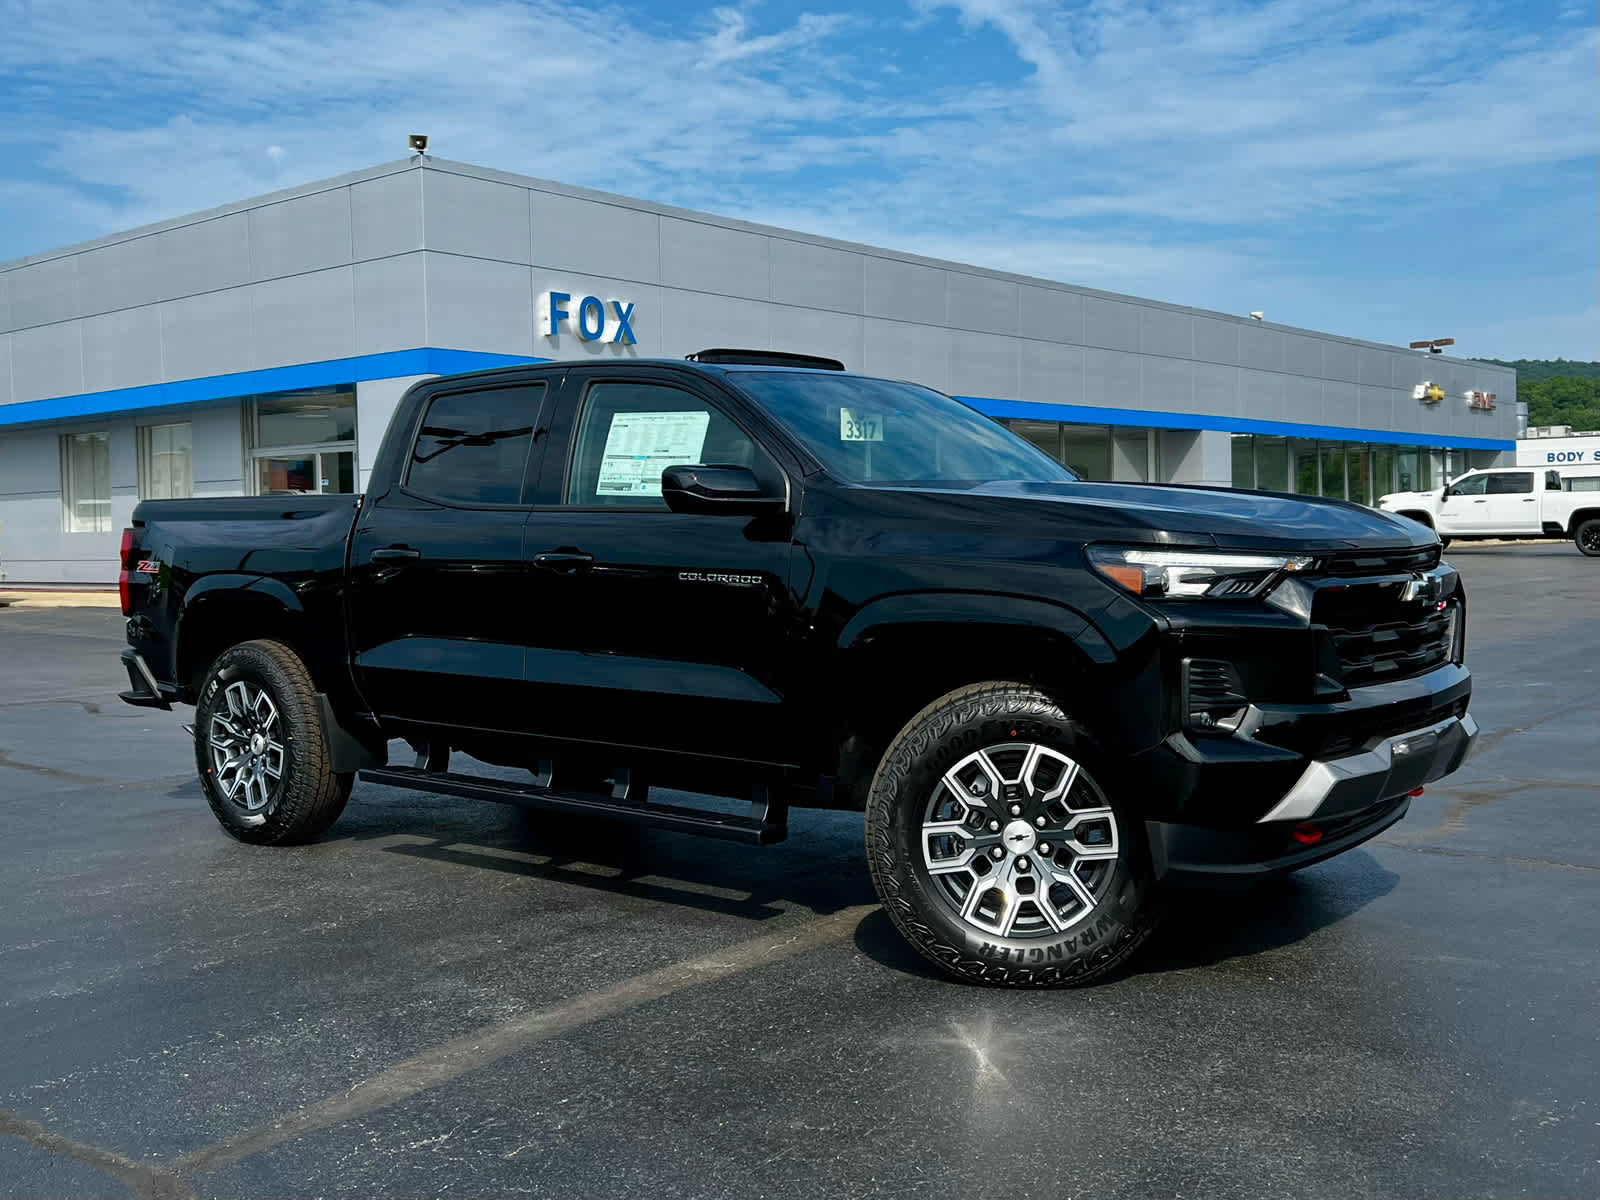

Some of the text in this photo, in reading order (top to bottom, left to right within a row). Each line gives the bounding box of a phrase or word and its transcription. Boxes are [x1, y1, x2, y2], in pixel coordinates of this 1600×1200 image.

[550, 291, 637, 344] FOX
[846, 420, 876, 439] 3317
[1547, 451, 1584, 462] BODY
[679, 572, 762, 584] COLORADO
[978, 912, 1118, 963] WRANGLER
